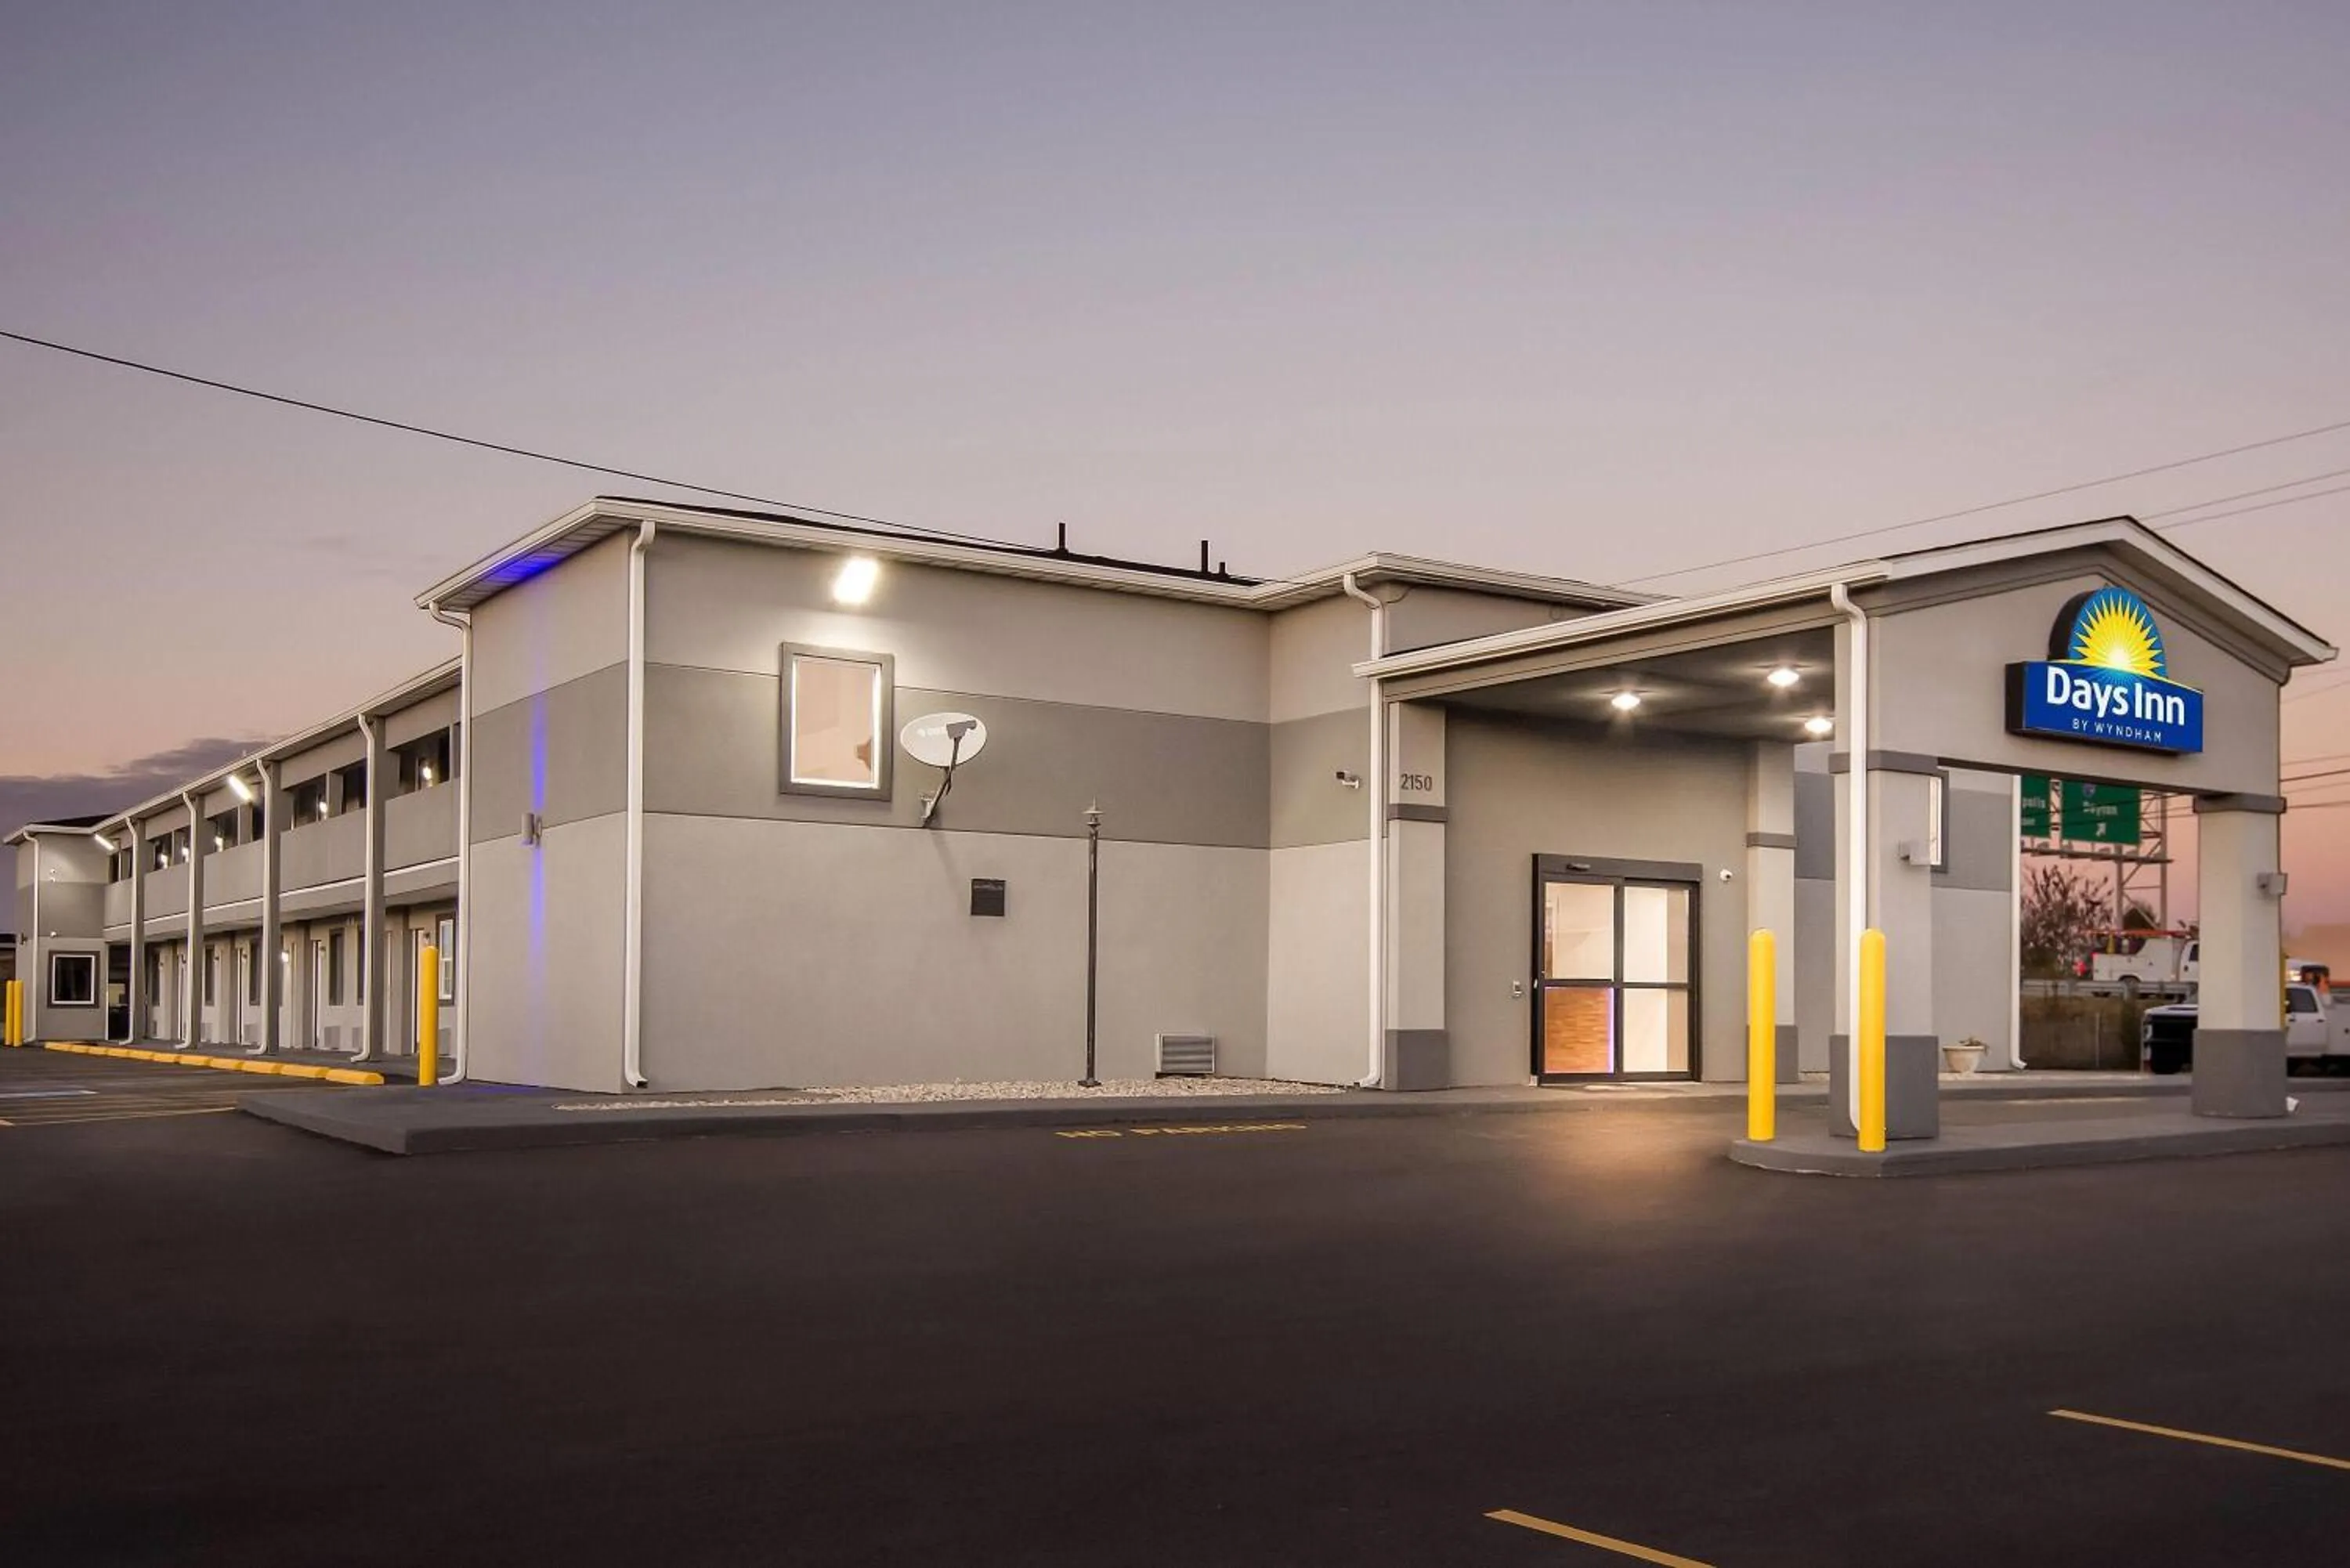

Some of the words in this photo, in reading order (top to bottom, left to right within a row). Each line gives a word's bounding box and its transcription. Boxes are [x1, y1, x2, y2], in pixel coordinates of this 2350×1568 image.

[2047, 666, 2129, 718] Days
[2135, 682, 2186, 726] Inn
[2072, 718, 2088, 731] BY
[2094, 721, 2162, 743] WYNDHAM
[1401, 773, 1433, 792] 2150
